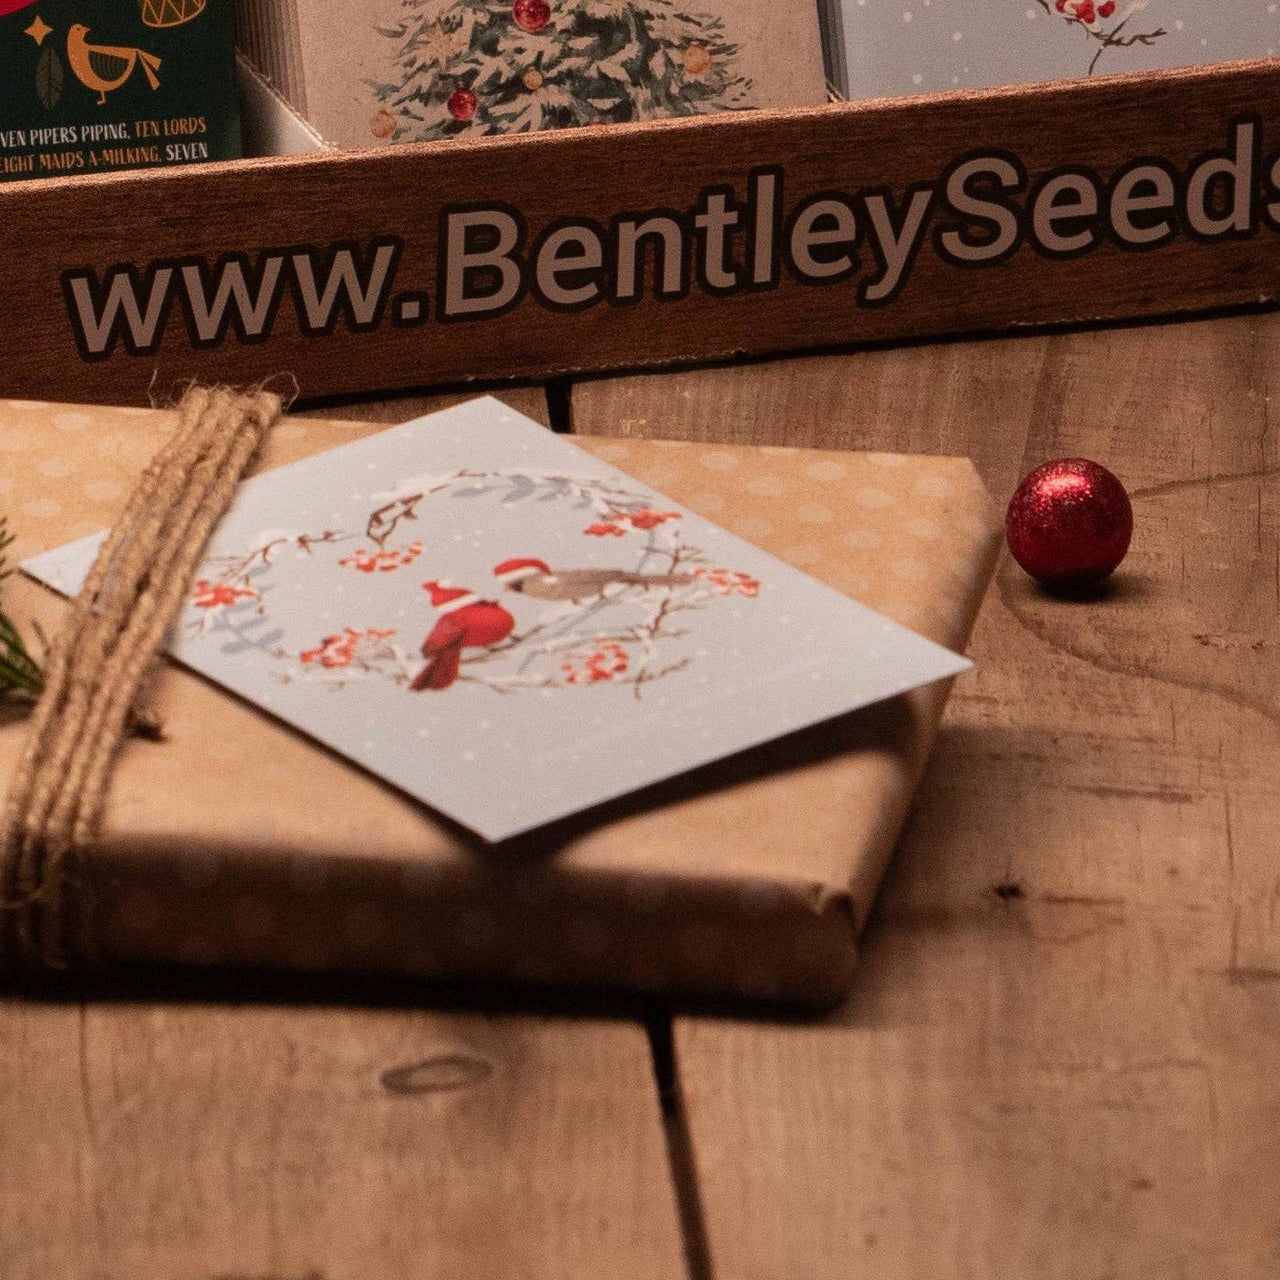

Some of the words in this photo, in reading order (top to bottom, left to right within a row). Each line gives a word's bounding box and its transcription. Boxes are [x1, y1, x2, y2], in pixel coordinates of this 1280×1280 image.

[29, 126, 77, 145] PIPERS
[134, 121, 159, 138] TEN
[163, 117, 207, 136] LORDS
[39, 150, 84, 170] MAIDS
[166, 141, 208, 161] SEVEN
